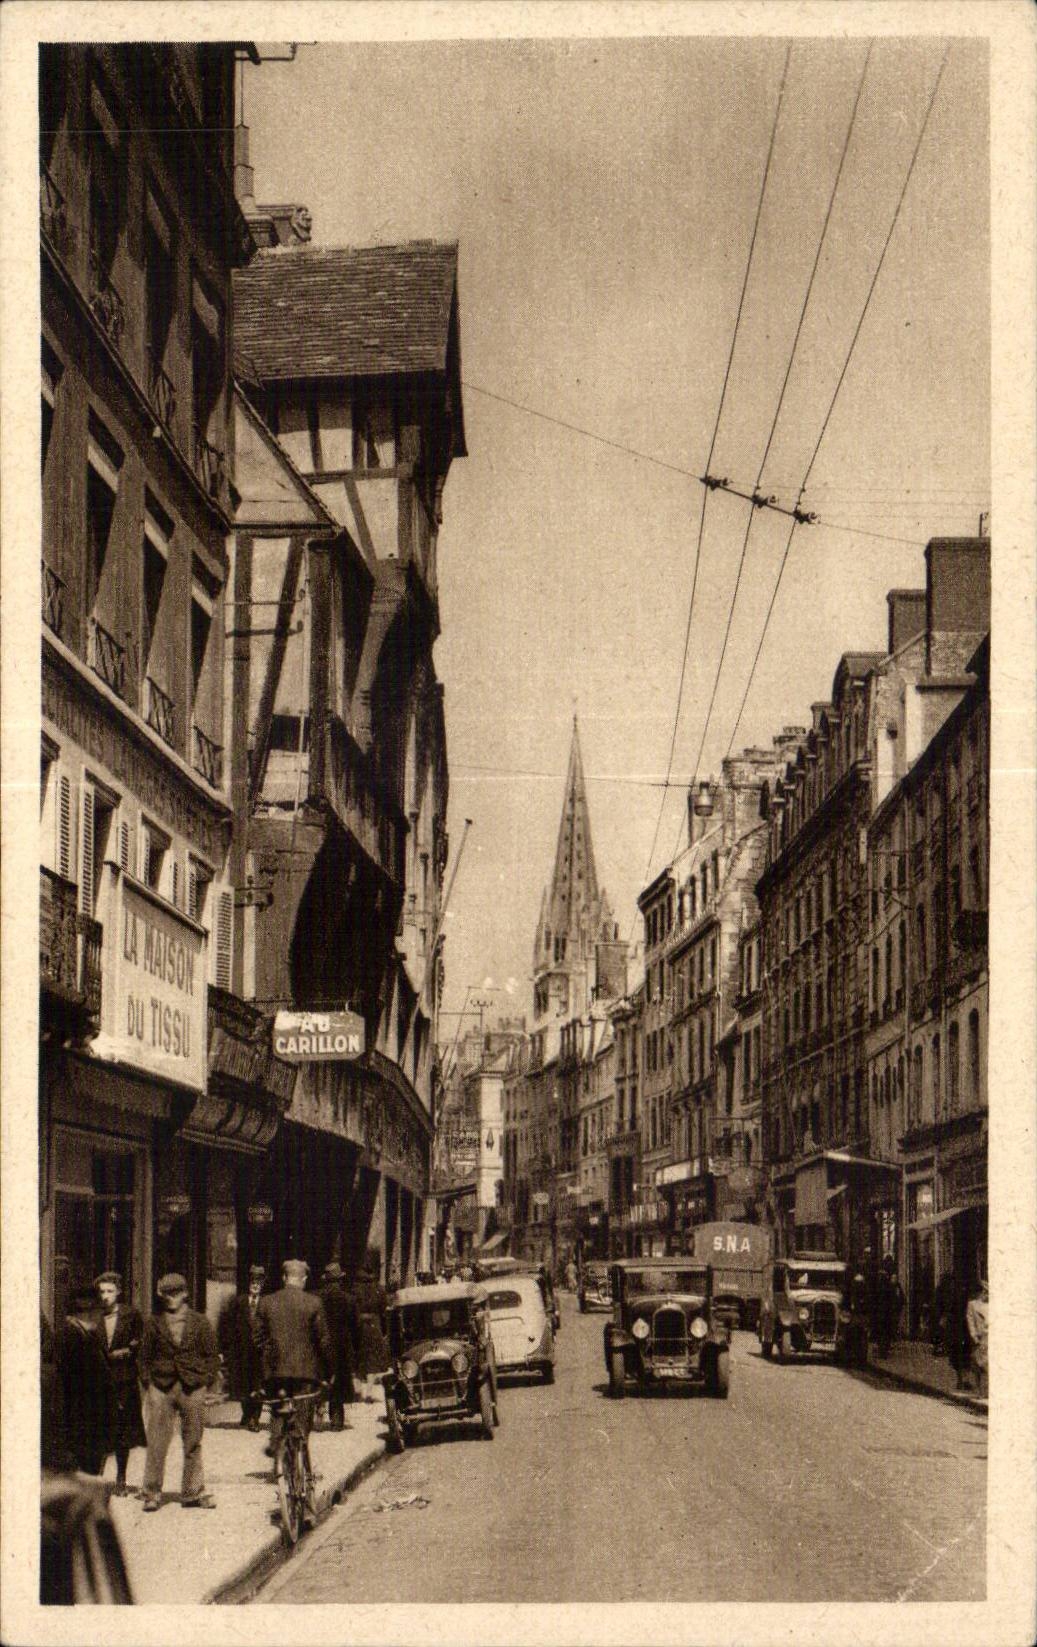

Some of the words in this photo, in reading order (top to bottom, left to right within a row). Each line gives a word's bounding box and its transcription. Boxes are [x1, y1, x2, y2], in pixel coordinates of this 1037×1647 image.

[124, 910, 138, 967] LA
[144, 920, 194, 997] MAISON
[127, 994, 145, 1041] DU
[150, 996, 191, 1058] TISSU
[275, 1034, 360, 1055] CARILLON
